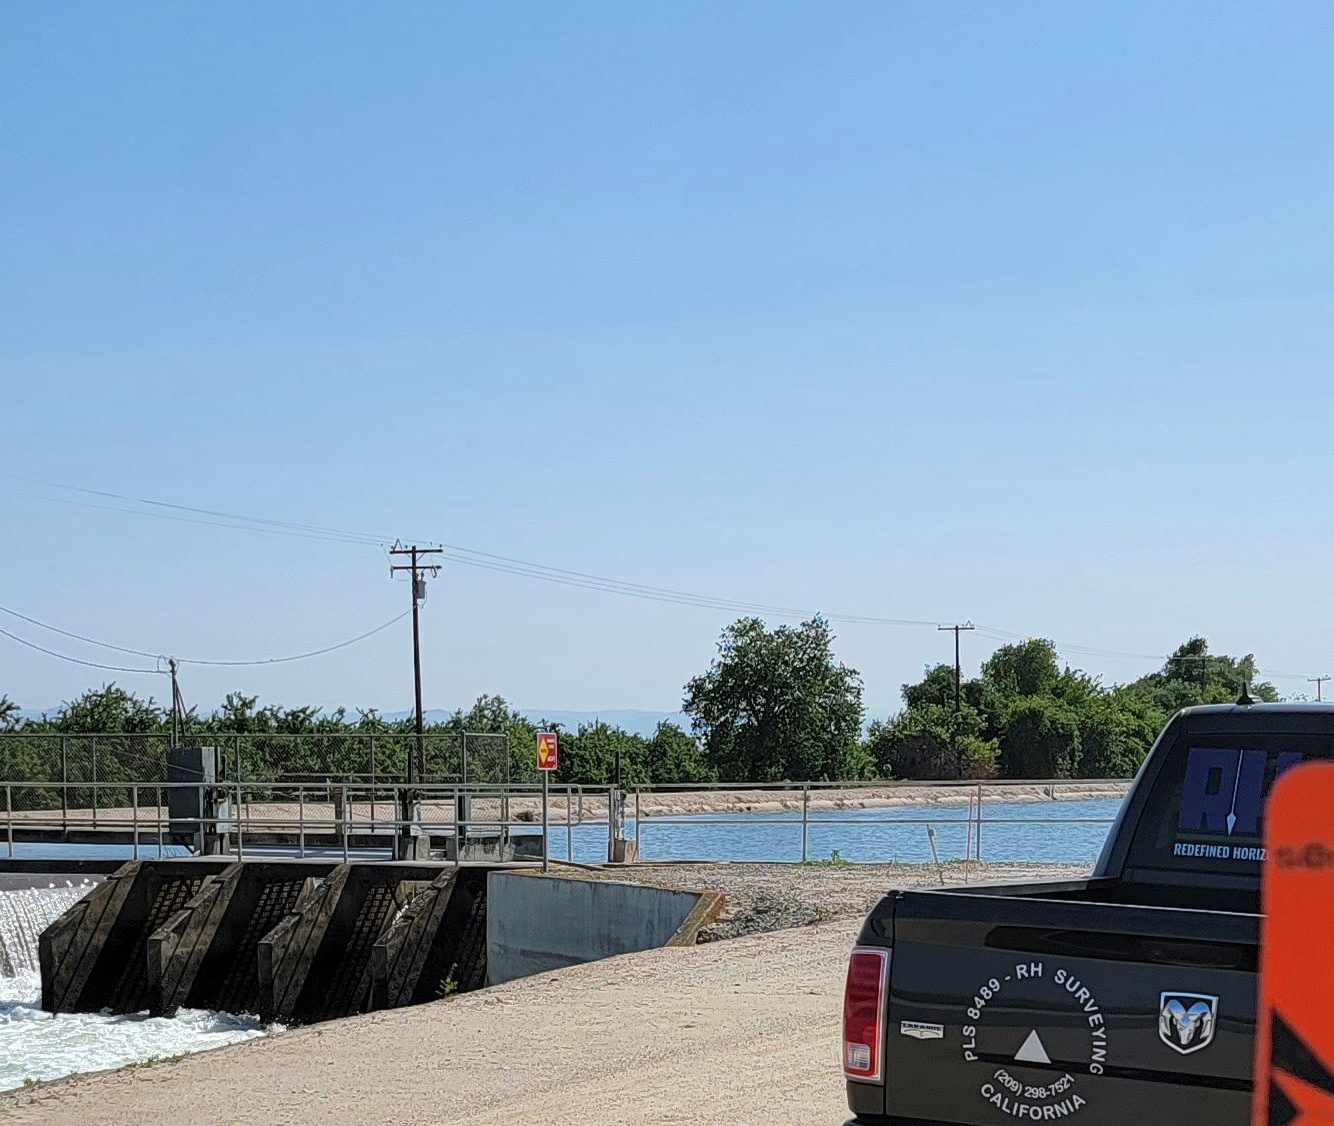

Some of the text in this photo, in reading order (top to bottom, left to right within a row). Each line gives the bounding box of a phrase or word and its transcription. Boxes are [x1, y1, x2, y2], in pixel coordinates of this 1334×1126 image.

[1174, 843, 1267, 861] REDEFINED HORIZ
[1016, 962, 1043, 980] RH
[967, 978, 1001, 1020] 8489
[1054, 969, 1107, 1075] SURVEYING
[962, 1025, 978, 1061] PLS
[981, 1083, 1087, 1120] CALIFORNIA
[993, 1069, 1075, 1099] (209) 298-7521
